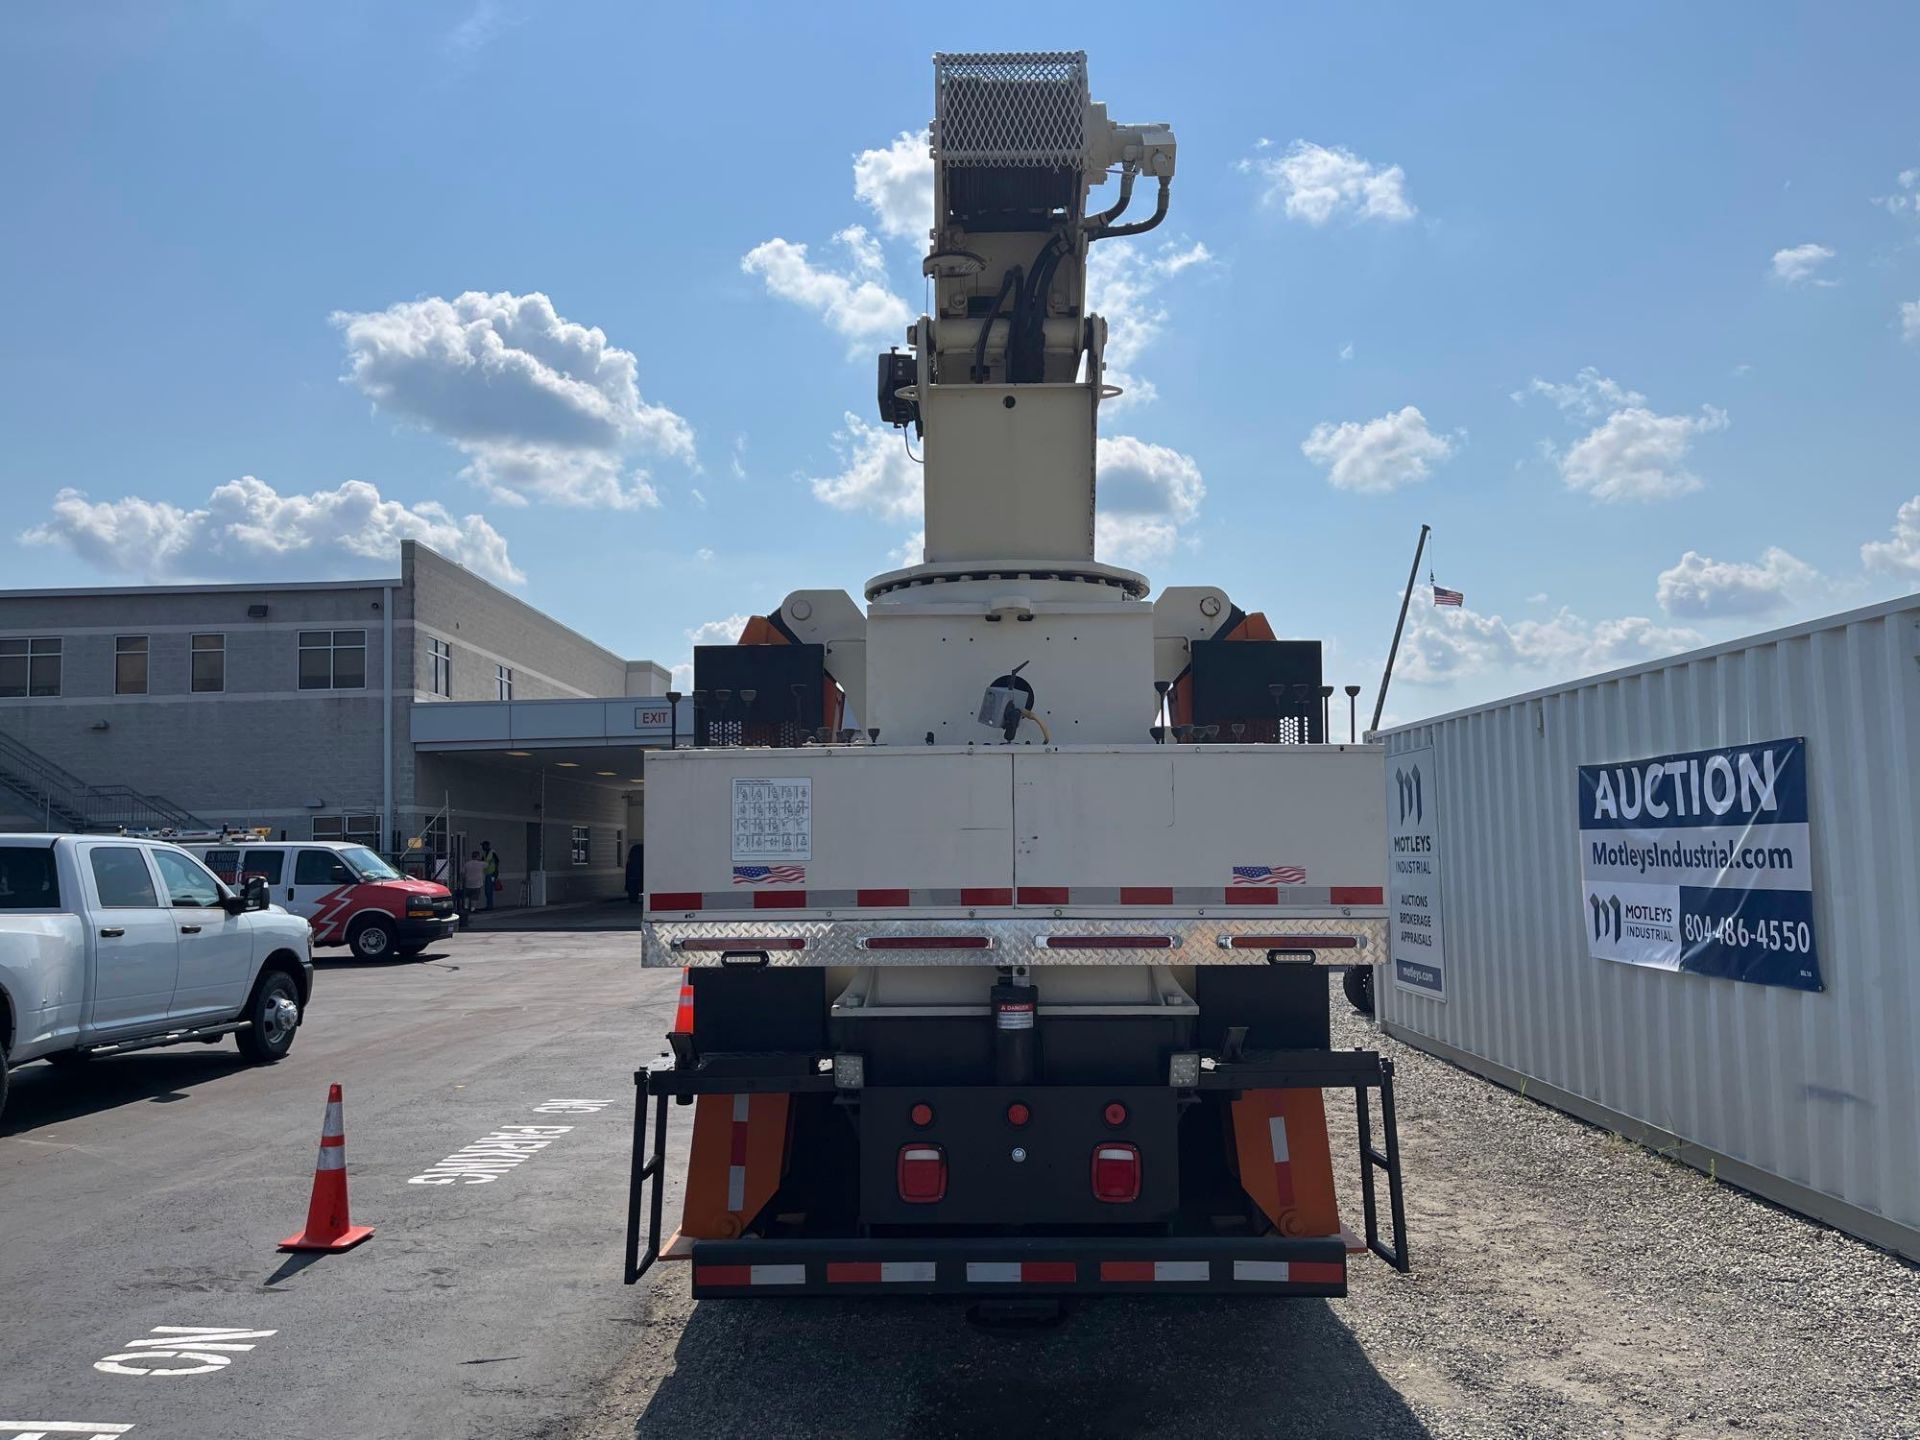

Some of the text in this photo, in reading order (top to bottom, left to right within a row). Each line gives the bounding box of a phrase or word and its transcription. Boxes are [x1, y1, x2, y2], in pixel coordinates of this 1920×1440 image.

[642, 712, 668, 724] EXIT
[1594, 750, 1777, 820] AUCTION
[1394, 835, 1431, 853] MOTLEYS
[1592, 839, 1793, 874] MotleysIndustrial.com
[1396, 860, 1432, 875] INDUSTRIAL
[1401, 894, 1428, 908] AUCTIONS
[1400, 912, 1432, 928] BROKERAGE
[1625, 903, 1673, 923] MOTLEYS
[1401, 930, 1432, 947] APPRAISALS
[1626, 925, 1674, 943] INDUSTRIAL
[1685, 913, 1811, 954] 804-486-4550
[407, 1125, 576, 1184] PARKING
[93, 1325, 279, 1376] NO
